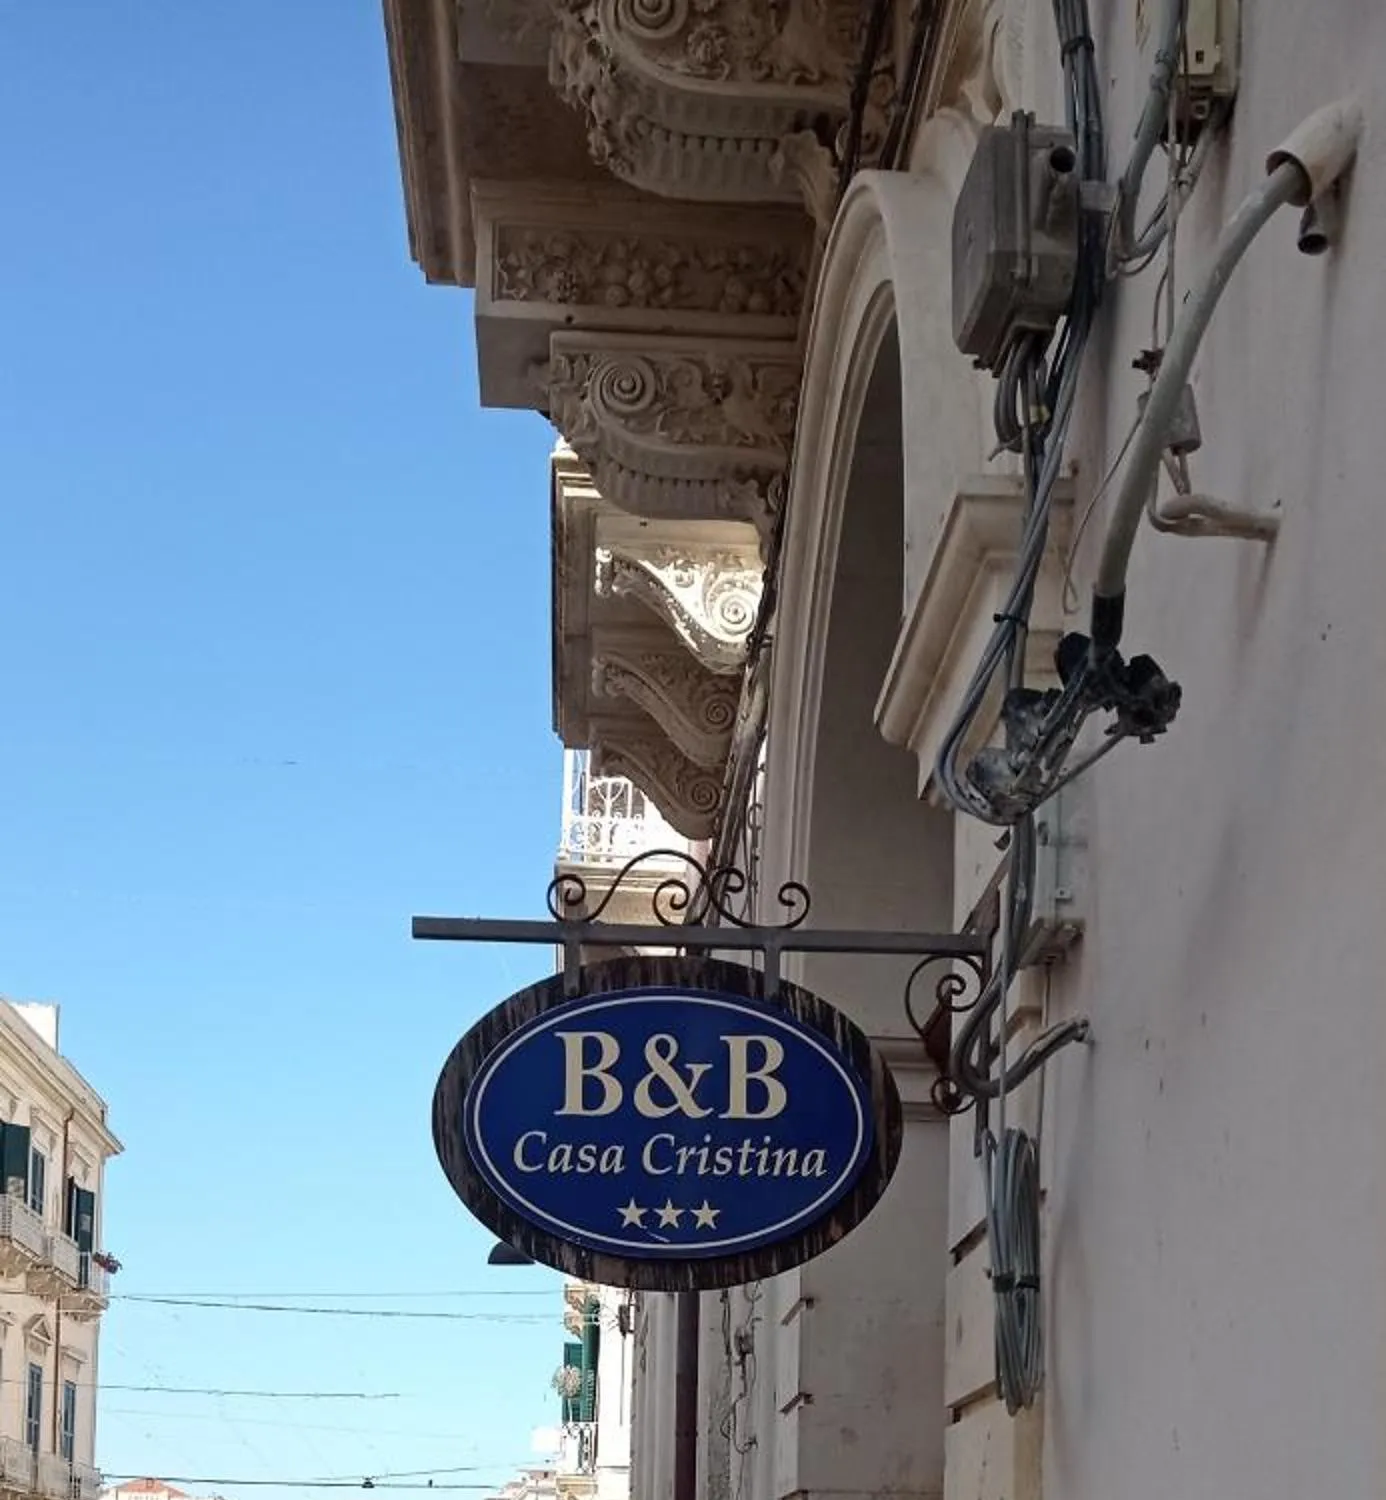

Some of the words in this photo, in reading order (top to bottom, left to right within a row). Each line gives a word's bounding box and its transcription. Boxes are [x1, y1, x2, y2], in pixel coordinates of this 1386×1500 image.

[554, 1031, 787, 1120] B&B
[513, 1131, 625, 1174] Casa
[642, 1132, 828, 1178] Cristina
